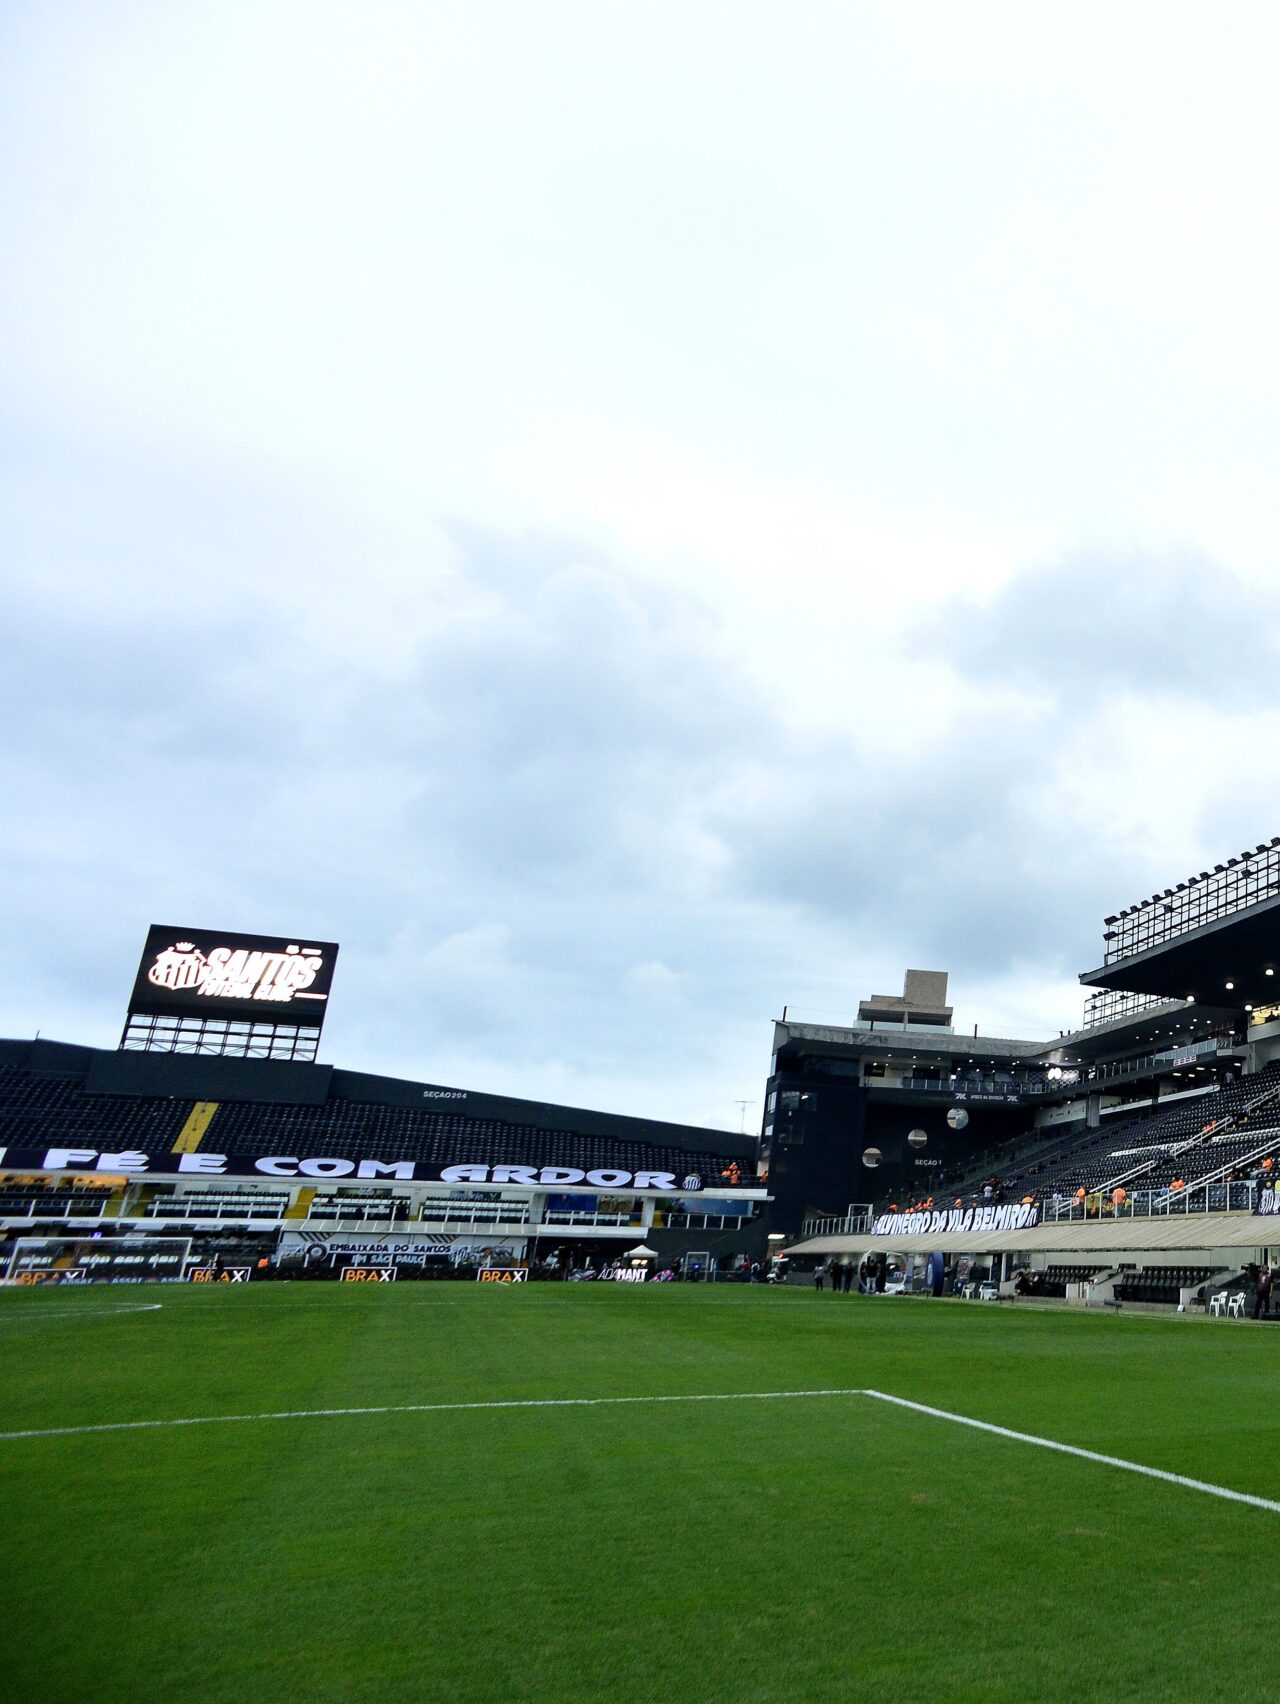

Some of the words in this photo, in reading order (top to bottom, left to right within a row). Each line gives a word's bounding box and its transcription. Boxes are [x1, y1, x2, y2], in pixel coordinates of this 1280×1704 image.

[204, 947, 323, 989] SANTOS
[43, 1149, 150, 1171] FÉ
[178, 1153, 228, 1173] E
[255, 1157, 416, 1179] COM
[440, 1164, 678, 1190] ARDOR
[875, 1211, 931, 1235] ALVINEGRO
[929, 1210, 948, 1232] DA
[946, 1207, 973, 1232] VILA
[971, 1203, 1031, 1231] BELMIRO
[329, 1244, 389, 1252] EMBAIXADA
[394, 1244, 409, 1252] DO
[413, 1245, 452, 1253] SANTOS
[344, 1269, 392, 1282] BRAX
[481, 1270, 524, 1282] BRAX
[597, 1268, 649, 1282] ADAMANT
